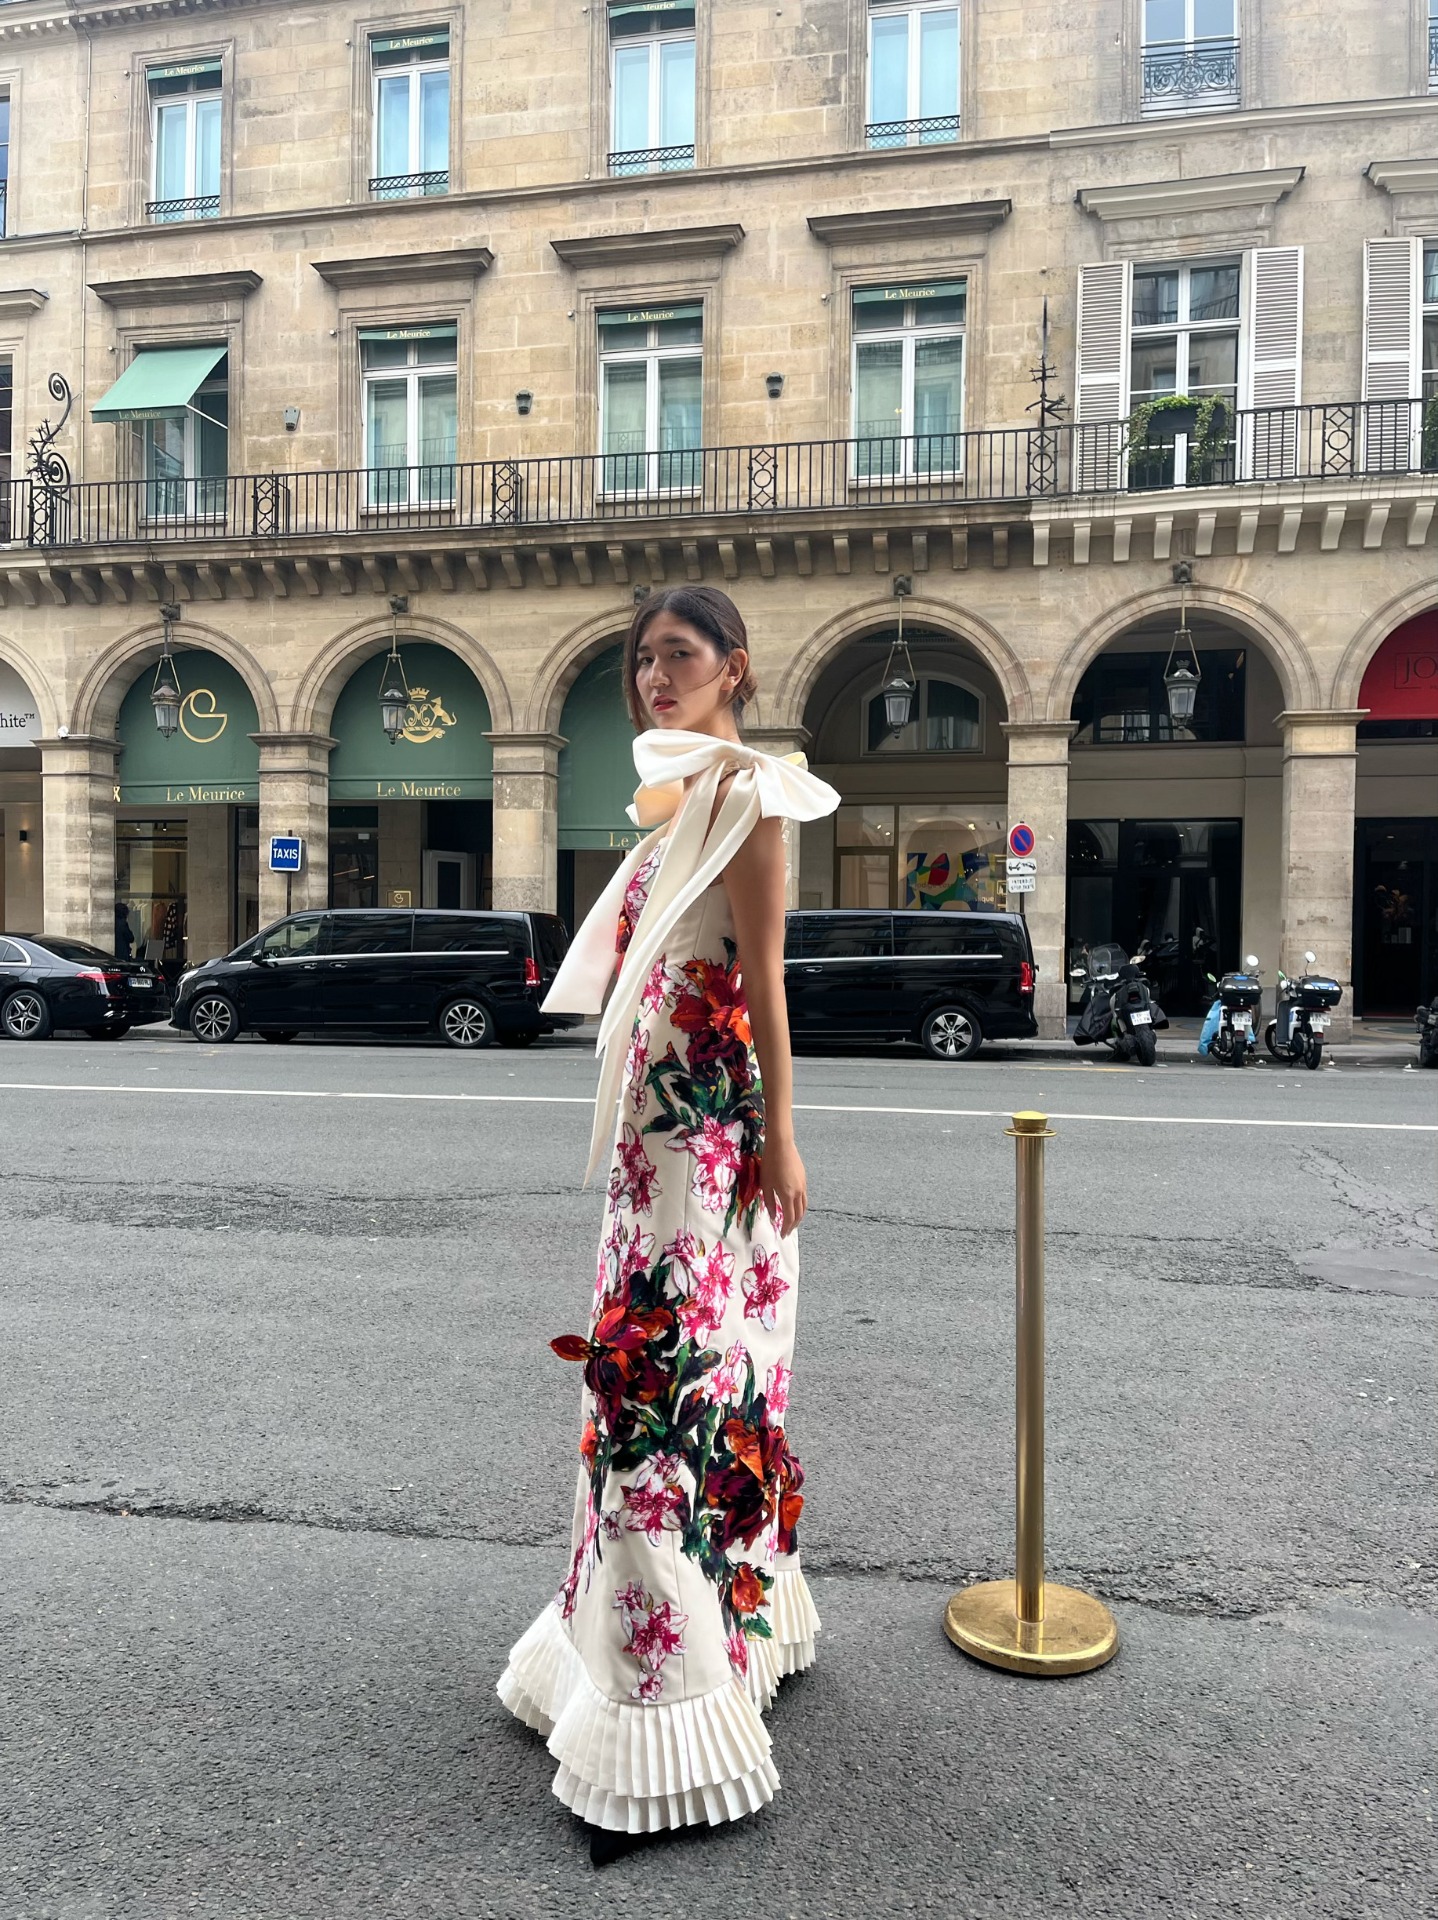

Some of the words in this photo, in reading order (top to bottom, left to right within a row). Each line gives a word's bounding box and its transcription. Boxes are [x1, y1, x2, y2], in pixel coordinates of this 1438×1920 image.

[390, 40, 401, 49] Le
[402, 37, 434, 47] Meurice
[164, 68, 175, 76] Le
[176, 64, 205, 75] Meurice
[884, 290, 897, 299] Le
[899, 288, 936, 298] Meurice
[627, 313, 638, 322] Le
[640, 311, 674, 320] Meurice
[386, 331, 398, 339] Le
[399, 330, 431, 339] Meurice
[118, 410, 130, 419] Le
[130, 409, 161, 419] Meurice
[166, 787, 184, 802] Le
[188, 786, 245, 801] Meurice
[376, 781, 396, 797] Le
[401, 781, 461, 797] Meurice
[608, 831, 630, 848] Le
[272, 847, 298, 860] TAXIS
